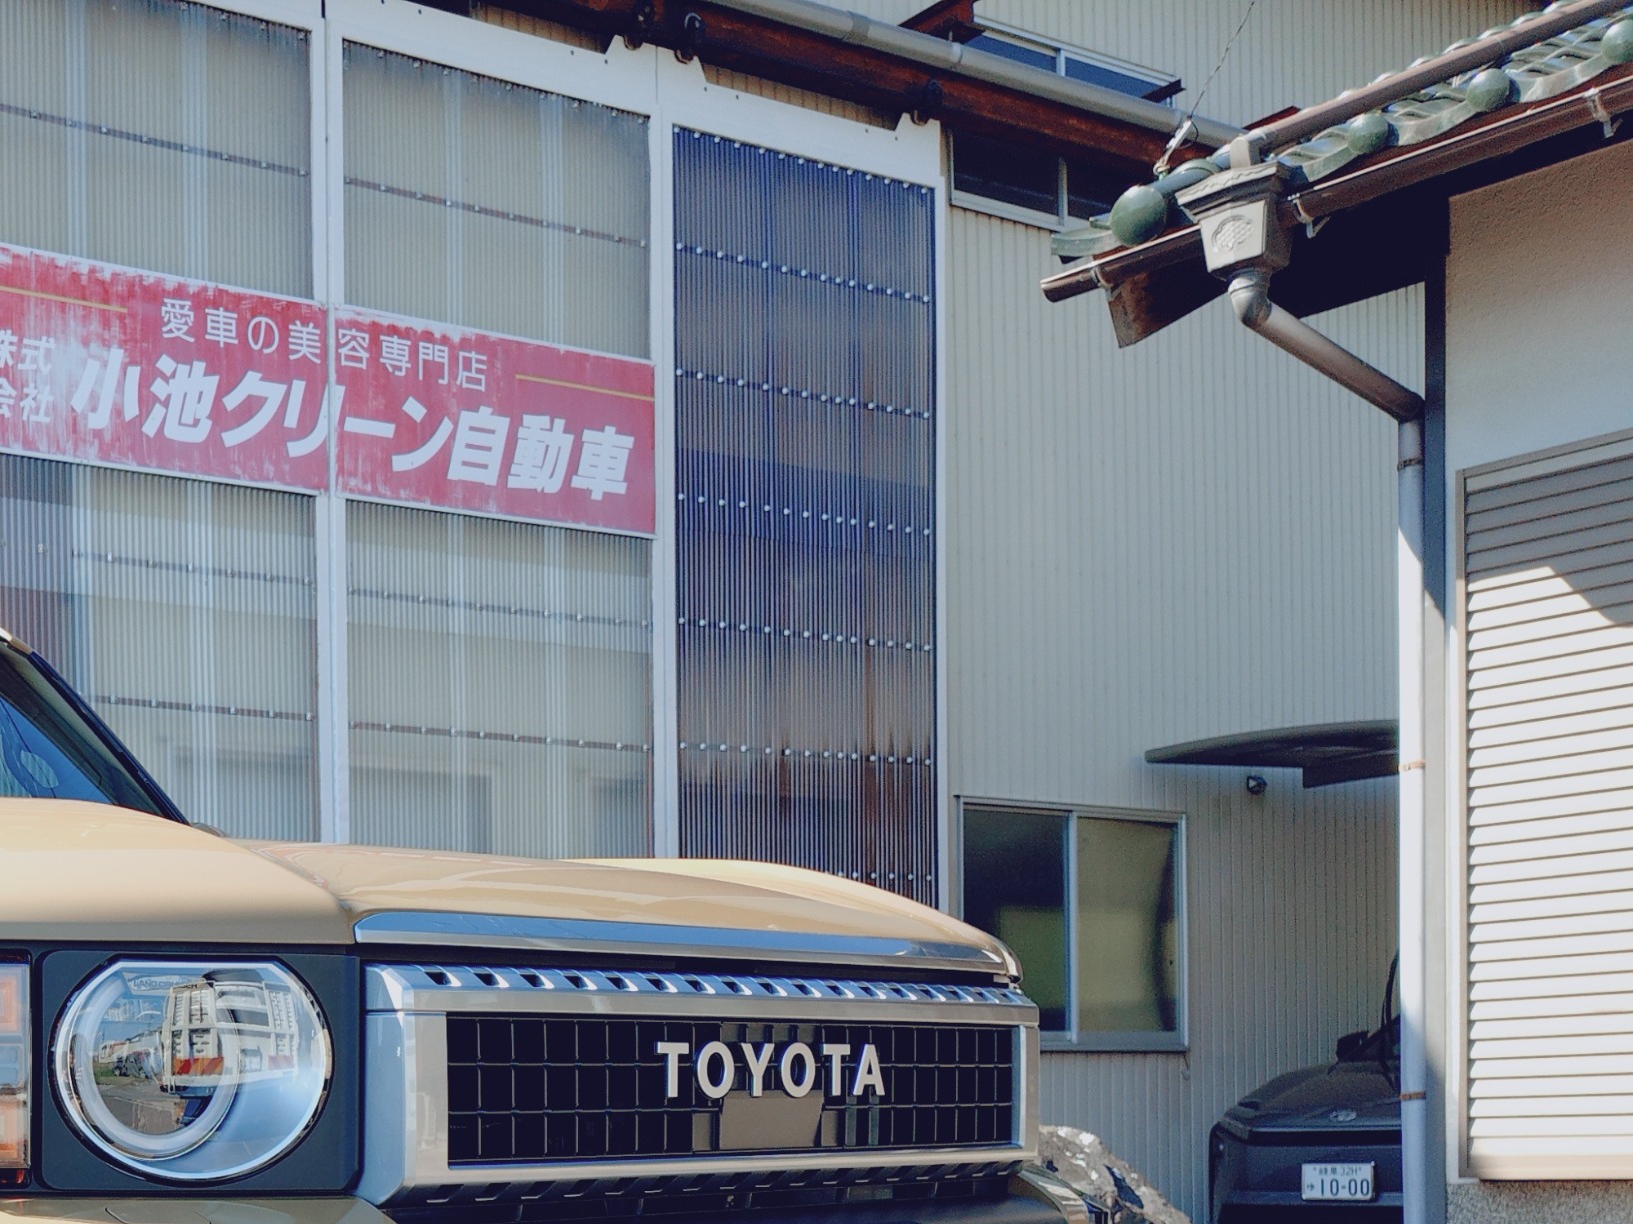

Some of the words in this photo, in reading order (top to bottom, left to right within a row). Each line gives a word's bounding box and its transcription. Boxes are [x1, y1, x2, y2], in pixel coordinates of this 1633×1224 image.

[161, 298, 487, 392] 愛車の美容専門店
[71, 347, 636, 500] 小池クリーン自動車
[657, 1041, 885, 1099] TOYOTA
[1320, 1178, 1370, 1196] 10-00
